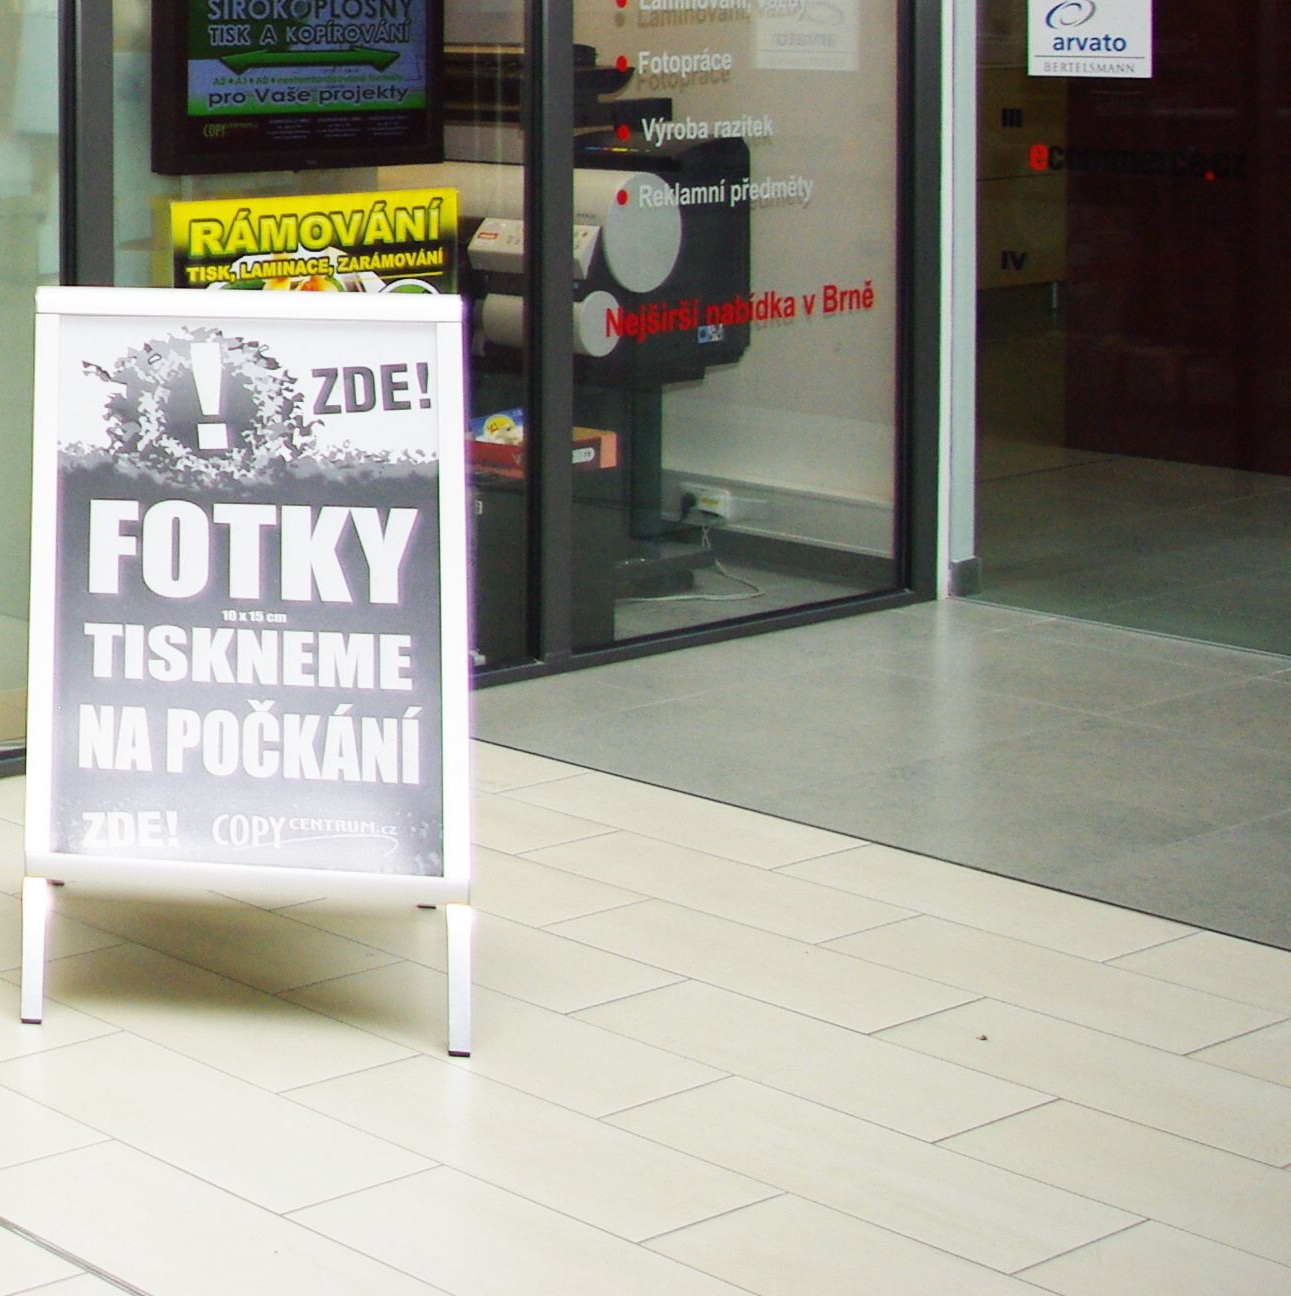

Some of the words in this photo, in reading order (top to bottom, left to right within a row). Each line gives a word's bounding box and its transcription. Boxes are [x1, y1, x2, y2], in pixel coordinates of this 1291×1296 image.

[207, 24, 251, 46] TISK
[260, 25, 279, 46] A
[285, 19, 412, 46] KOPÍROVÁNÍ
[1052, 34, 1127, 53] arvato
[637, 48, 733, 76] Fotopráce
[1044, 60, 1135, 75] BERTELSMANN
[208, 90, 247, 108] pro
[255, 86, 312, 103] Vaše
[319, 84, 409, 105] projekty
[642, 117, 709, 147] Výroba
[713, 114, 774, 138] razítek
[638, 179, 726, 207] Reklamní
[730, 176, 815, 207] předměty
[188, 197, 444, 259] RÁMOVÁNÍ
[186, 264, 237, 283] TISK,
[240, 256, 333, 281] LAMINACE,
[337, 247, 444, 273] ZARÁMOVÁNÍ
[605, 299, 700, 343] Nejširší
[705, 291, 796, 327] nabídka
[804, 294, 817, 316] v
[822, 280, 875, 315] Brně
[312, 362, 432, 416] ZDE!
[88, 498, 420, 605] FOTKY
[222, 609, 237, 622] 10
[239, 612, 248, 623] x
[249, 611, 265, 623] 15
[267, 614, 288, 624] cm
[83, 622, 413, 691] TISKNEME
[78, 703, 153, 773] NA
[166, 698, 423, 785] POČKÁNÍ
[82, 810, 179, 849] ZDE!
[212, 814, 285, 850] COPY
